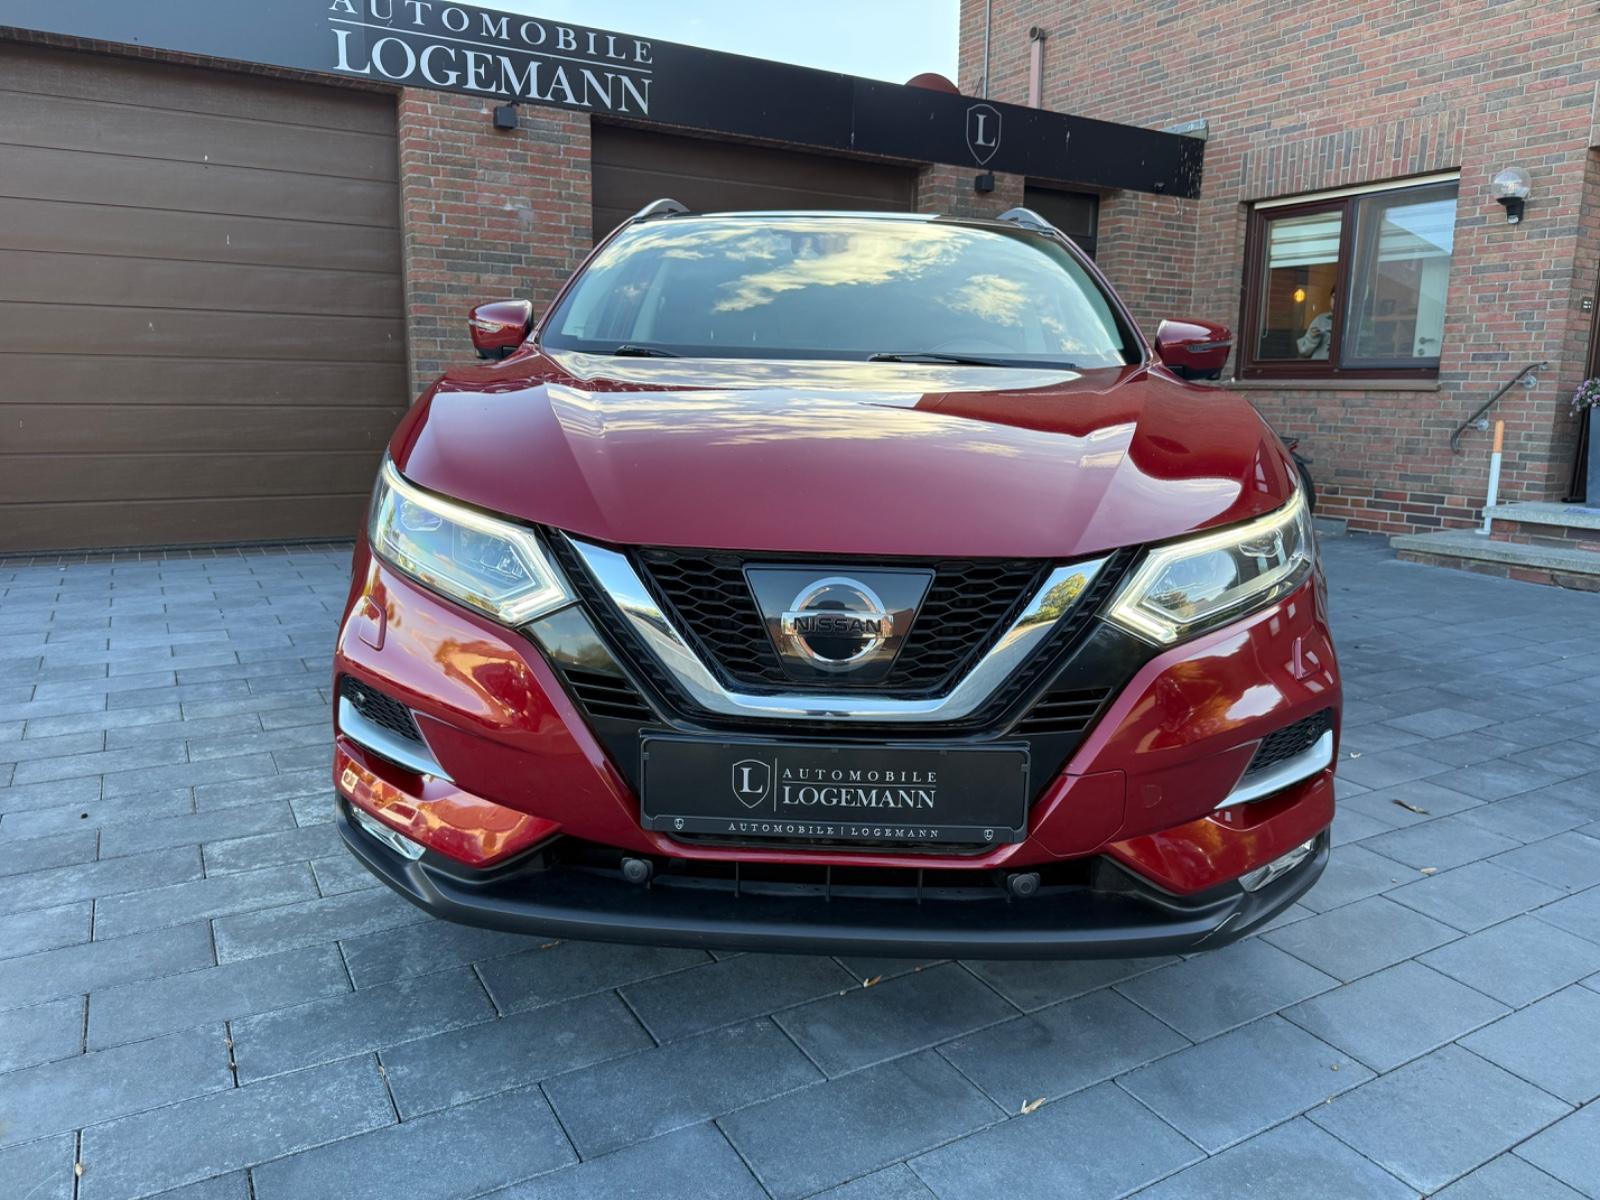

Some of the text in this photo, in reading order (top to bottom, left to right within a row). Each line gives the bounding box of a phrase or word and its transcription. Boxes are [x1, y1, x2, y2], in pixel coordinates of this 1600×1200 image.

[331, 28, 653, 116] LOGEMANN
[975, 113, 996, 147] L
[793, 616, 882, 634] NISSAN
[740, 767, 763, 793] L
[782, 767, 937, 783] AUTOMOBILE
[782, 785, 937, 809] LOGEMANN
[728, 822, 939, 838] AUTOMOBILE LOGEMANN
